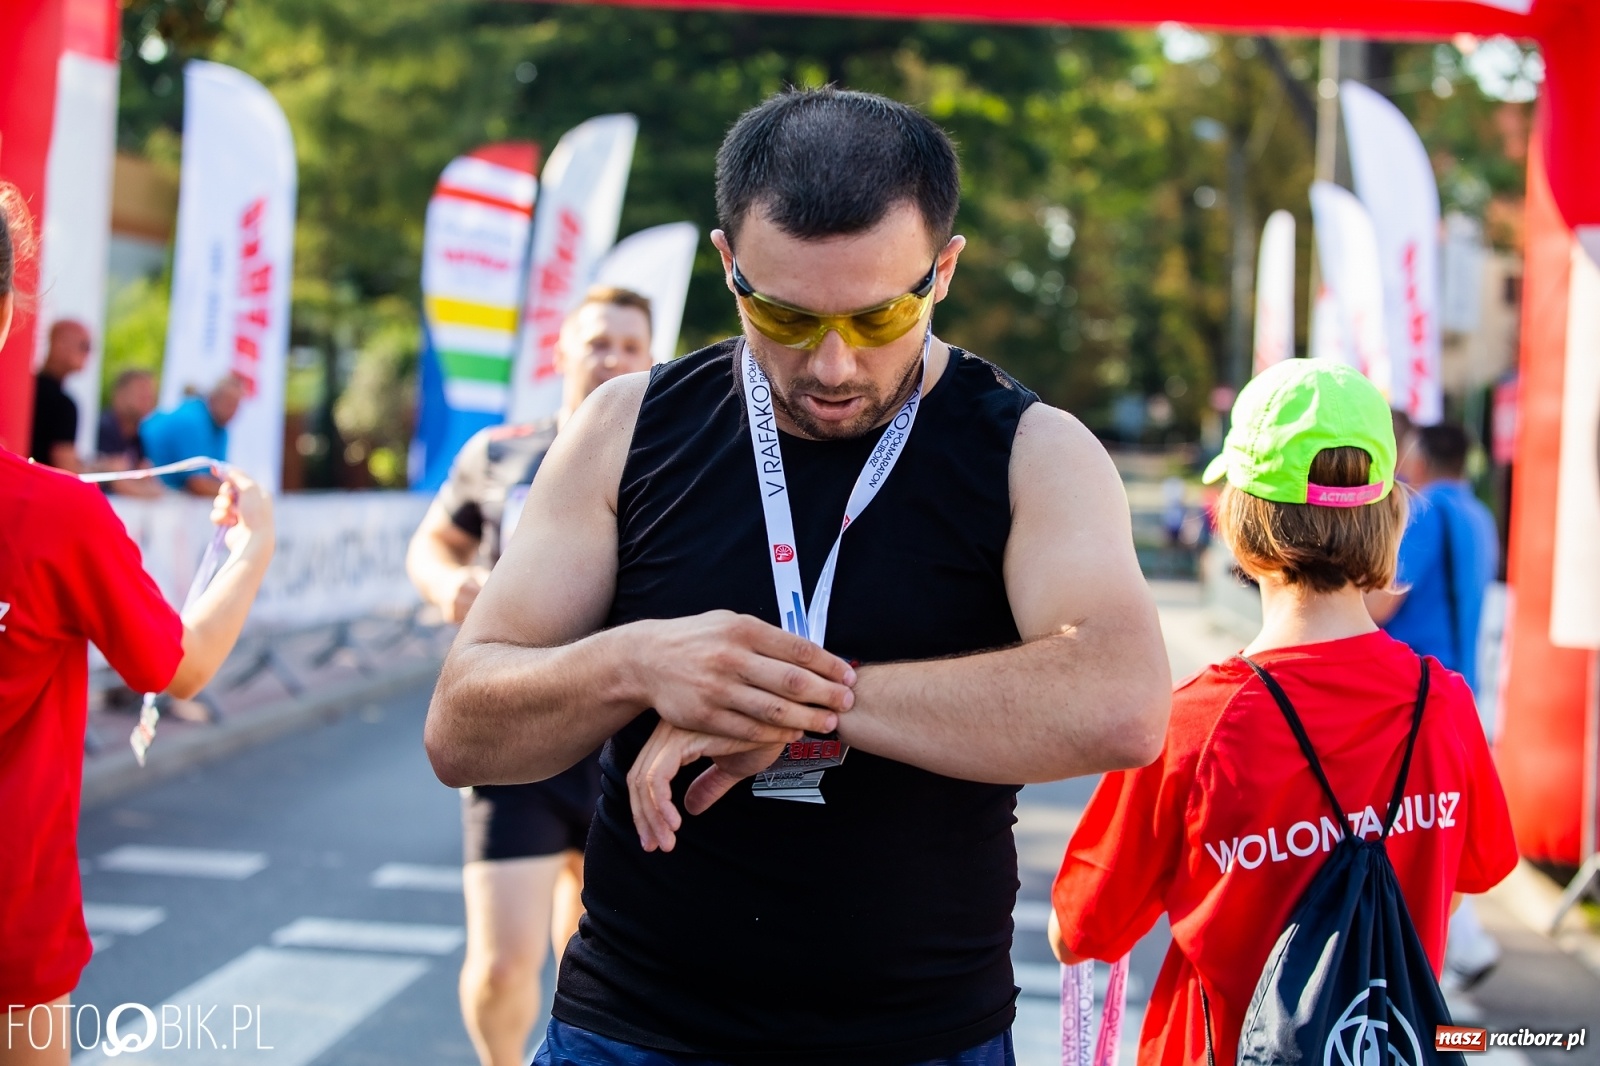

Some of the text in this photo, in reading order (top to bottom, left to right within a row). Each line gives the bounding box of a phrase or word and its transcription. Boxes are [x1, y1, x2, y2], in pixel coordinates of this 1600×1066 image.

[752, 385, 785, 497] V RAFAKO
[868, 428, 896, 468] RACIBÓRZ
[868, 431, 905, 489] PÓŁMARATON
[1319, 491, 1357, 503] ACTIVE
[789, 740, 842, 760] BIEGI
[1205, 791, 1461, 874] WOLONTARIUSZ
